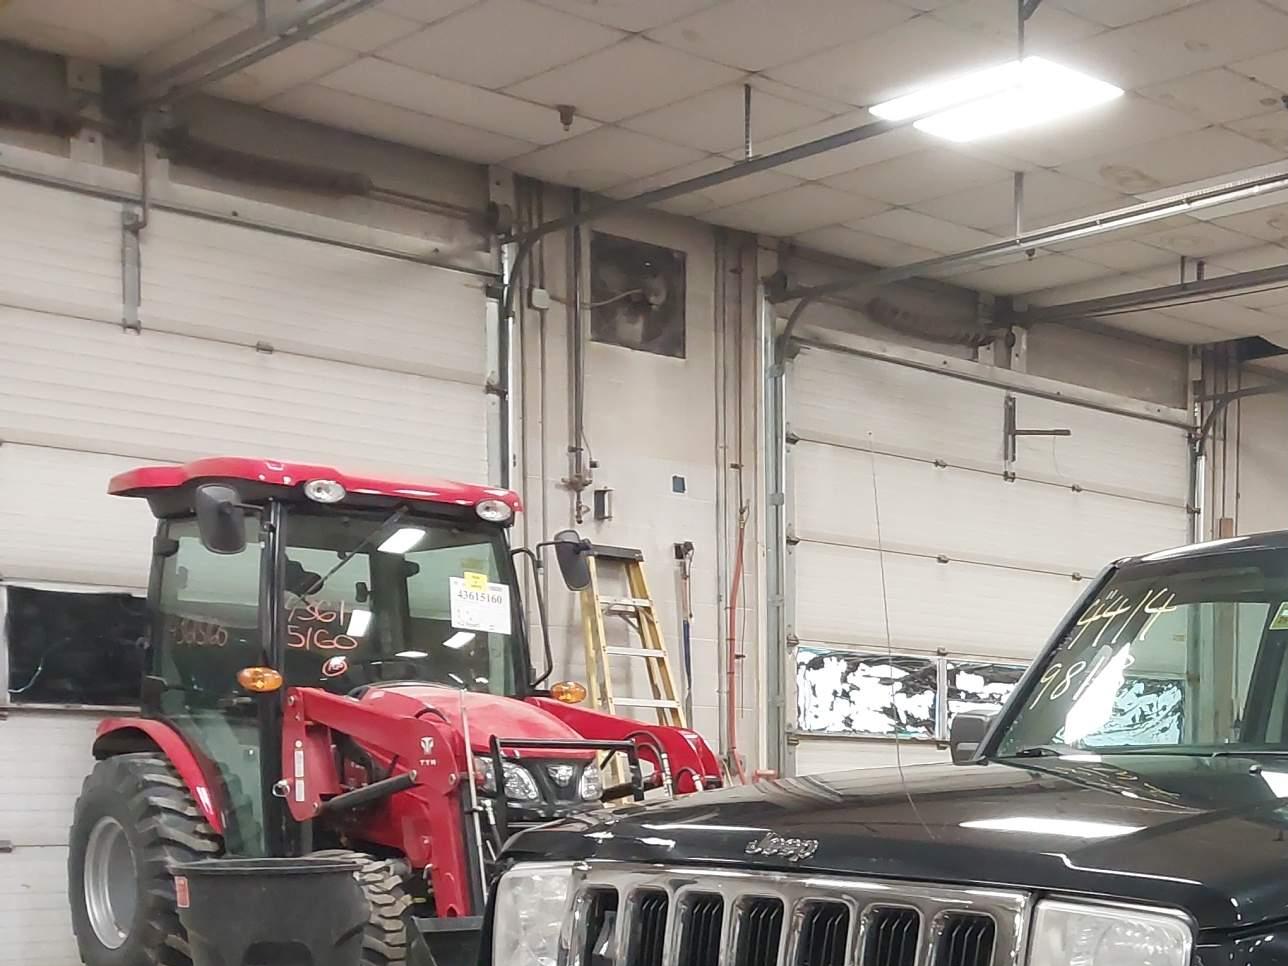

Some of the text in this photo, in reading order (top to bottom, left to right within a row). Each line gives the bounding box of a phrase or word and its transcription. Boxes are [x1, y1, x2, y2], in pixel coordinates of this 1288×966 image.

[457, 589, 503, 604] 43615160
[287, 624, 358, 650] 5160
[744, 832, 819, 862] Jeep
